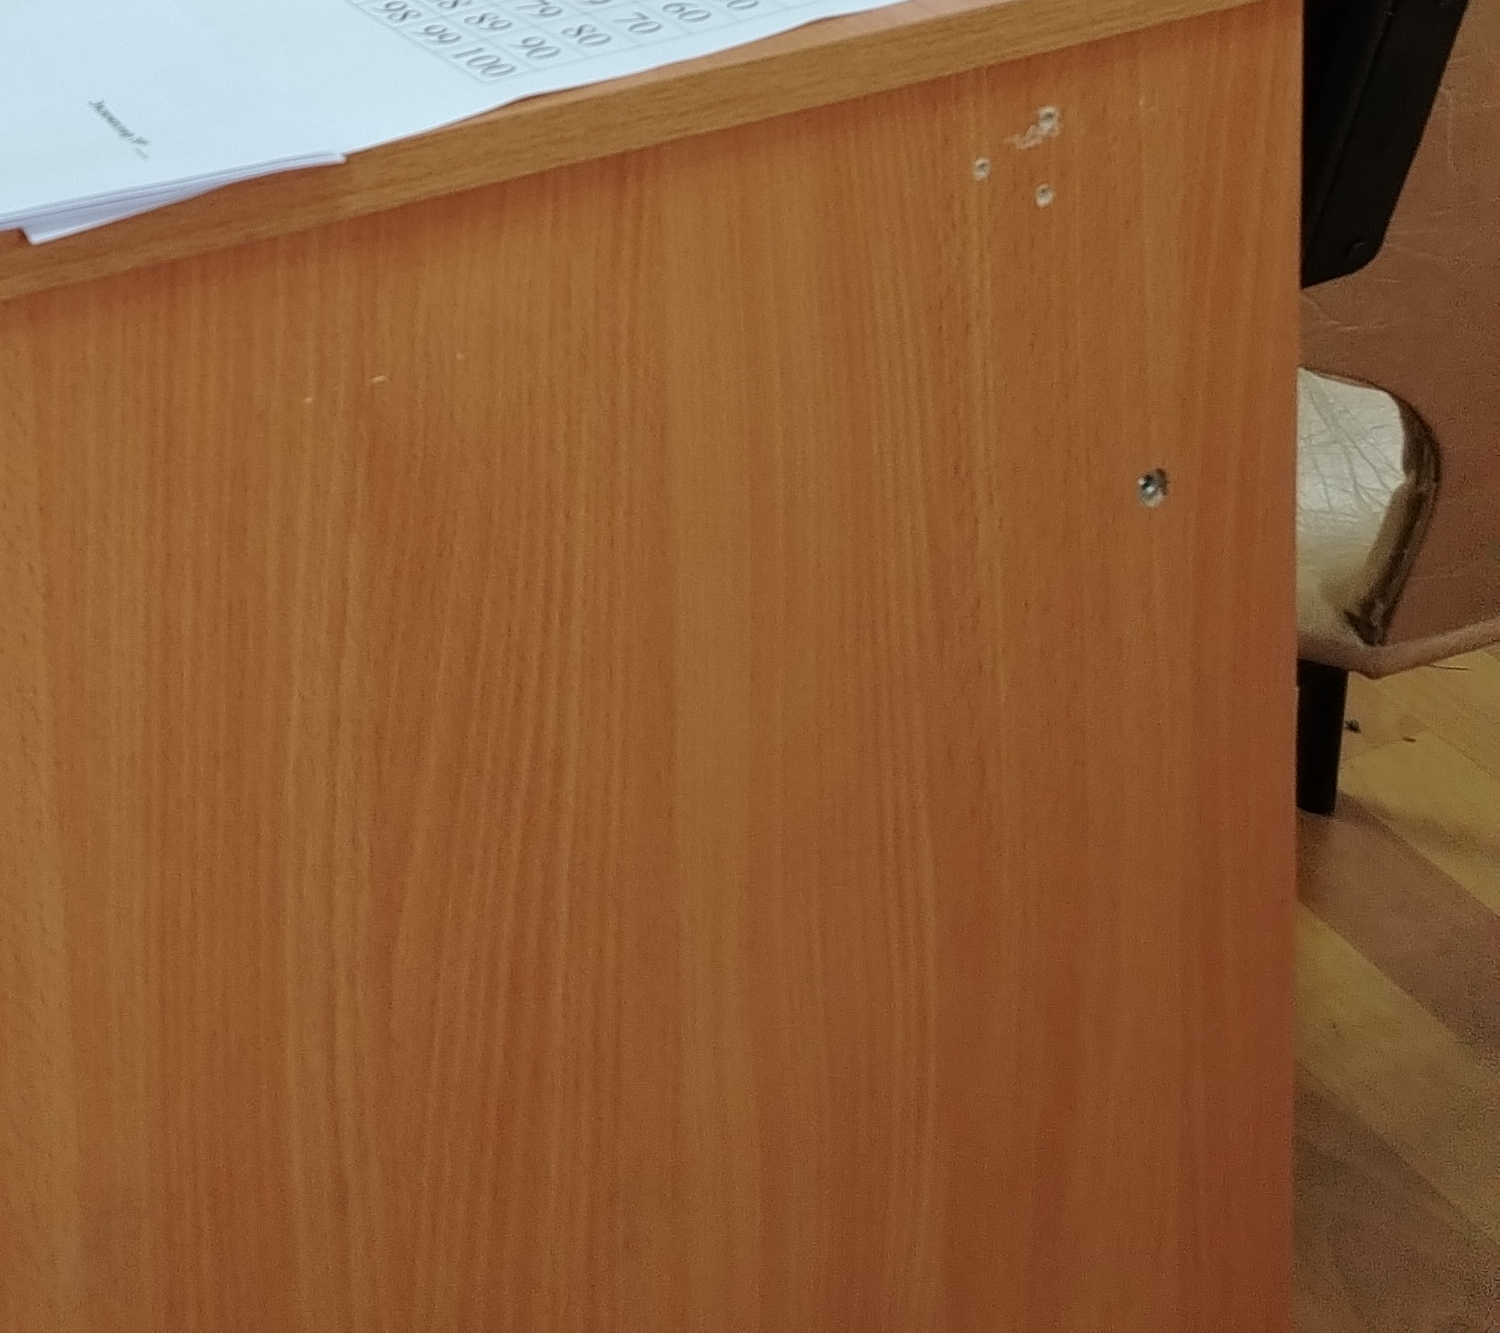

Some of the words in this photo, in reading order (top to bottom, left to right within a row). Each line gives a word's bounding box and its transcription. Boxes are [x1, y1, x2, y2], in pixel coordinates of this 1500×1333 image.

[662, 2, 711, 22] 60
[382, 1, 421, 21] 98
[420, 25, 461, 43] 99
[453, 47, 515, 76] 100
[561, 24, 611, 46] 80
